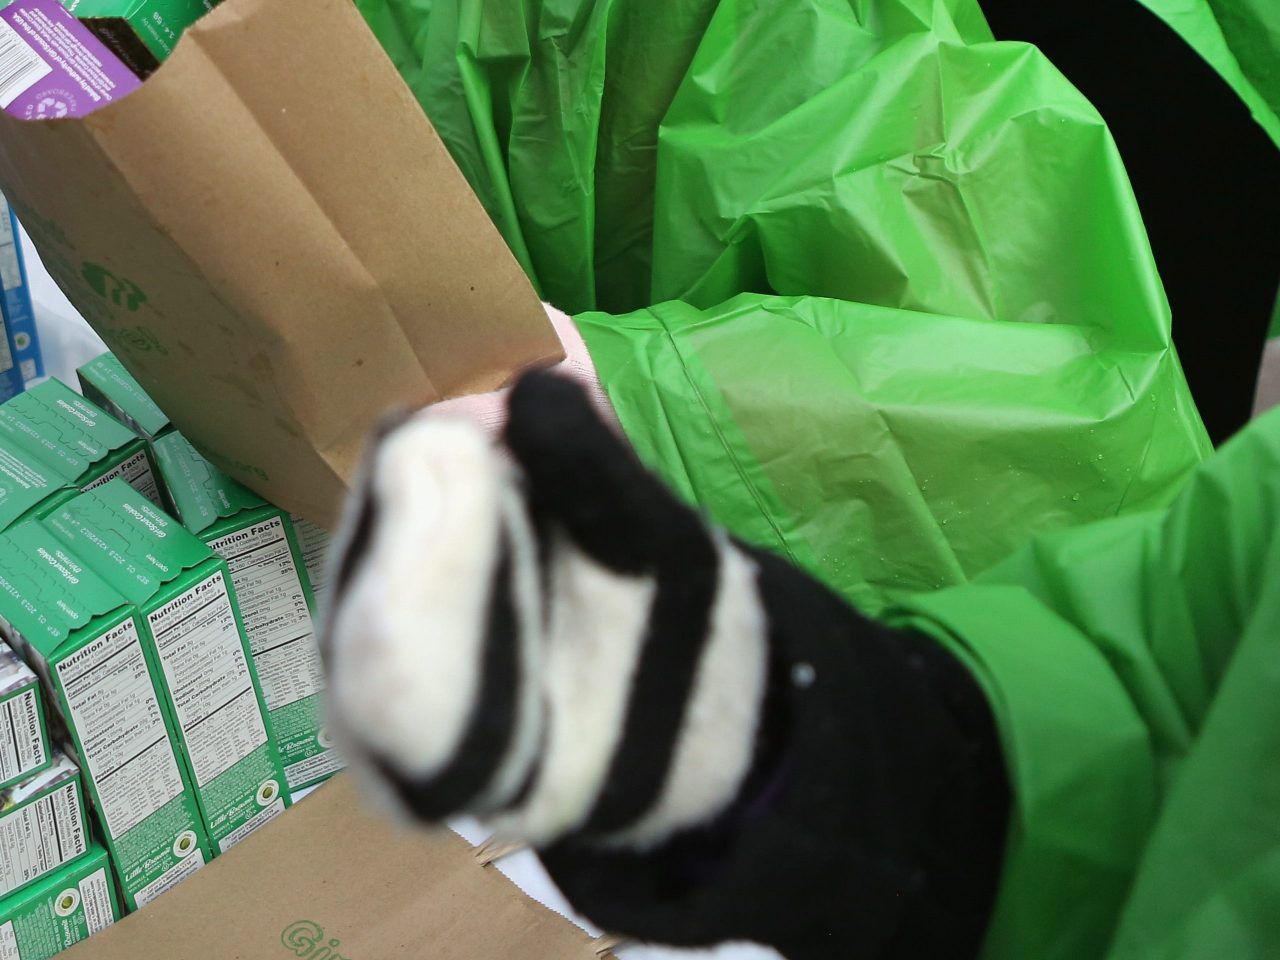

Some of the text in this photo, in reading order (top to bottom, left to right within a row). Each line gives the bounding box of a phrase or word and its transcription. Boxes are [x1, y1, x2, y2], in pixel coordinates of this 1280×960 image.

[21, 21, 32, 31] the
[32, 32, 50, 49] Scouts
[46, 46, 58, 57] Girl
[58, 59, 82, 82] authority
[56, 397, 76, 412] Cookies
[71, 408, 87, 420] Scout
[121, 501, 167, 539] Girl Scout Cookies
[154, 514, 168, 527] thin
[209, 519, 280, 550] utrition Facts
[35, 545, 80, 586] Girl Scout Cookies
[68, 561, 82, 574] thin
[20, 598, 37, 614] 2013
[149, 573, 221, 623] Nutrition Facts
[58, 619, 132, 672] Nutrition Facts
[175, 687, 194, 702] Sodium
[177, 675, 226, 708] Total Carbohydrate
[23, 691, 43, 764] Nutrition Facts
[85, 736, 106, 752] Sodium
[88, 723, 139, 759] Total Carbohydrate
[65, 783, 82, 854] Nutrition Facts
